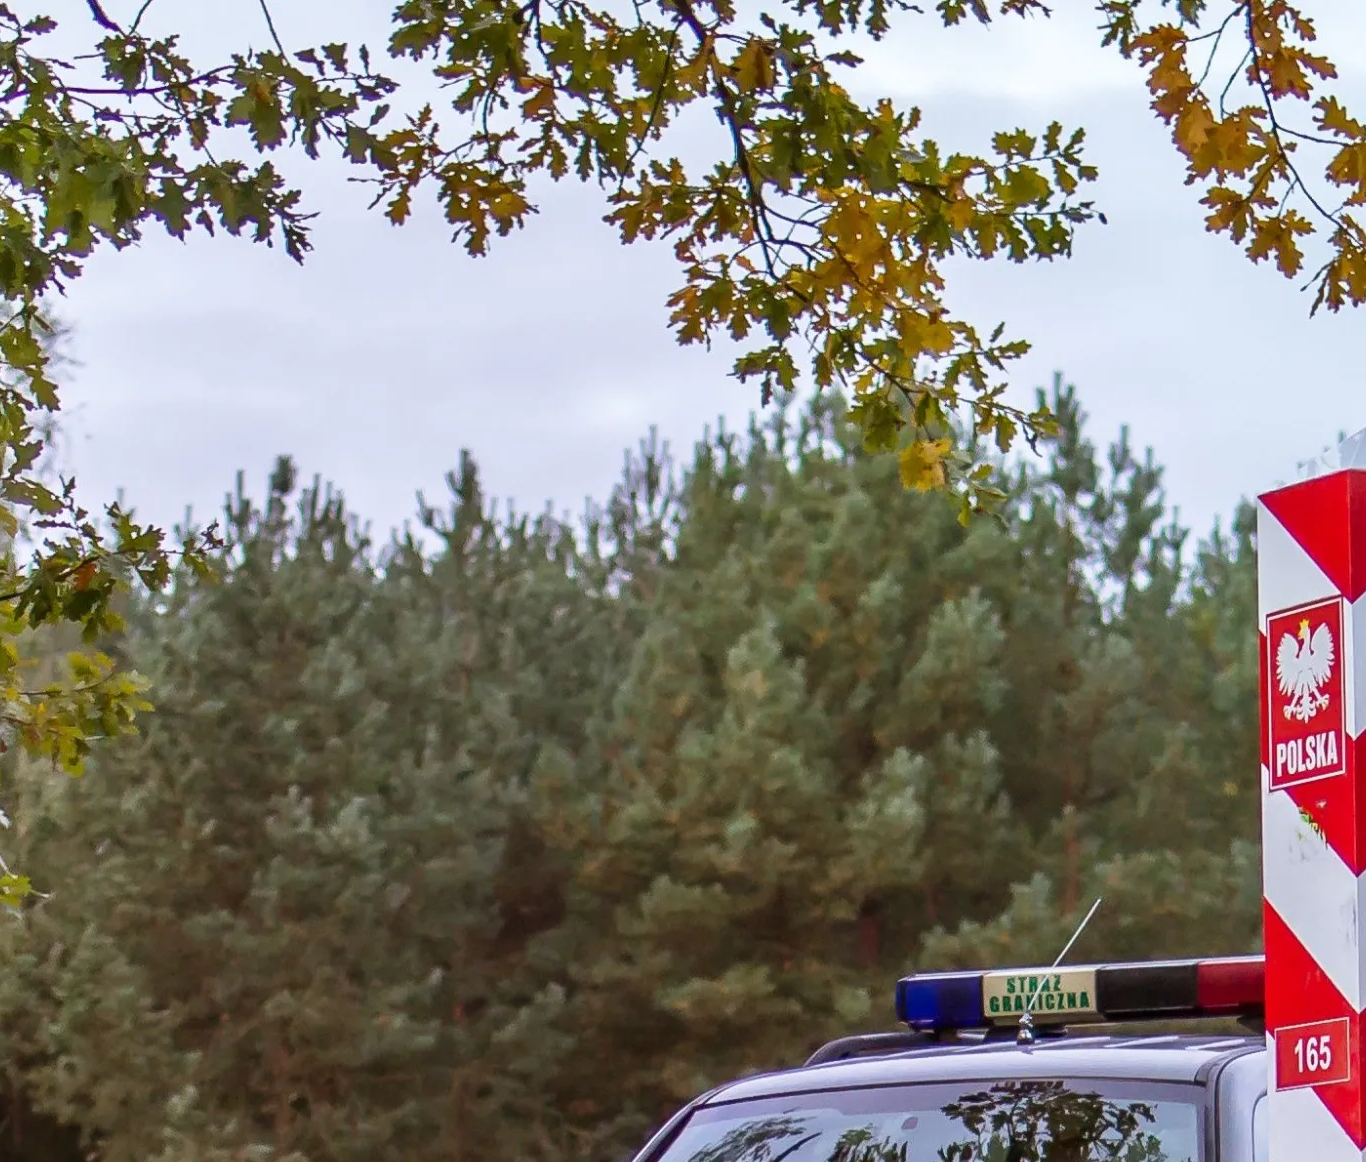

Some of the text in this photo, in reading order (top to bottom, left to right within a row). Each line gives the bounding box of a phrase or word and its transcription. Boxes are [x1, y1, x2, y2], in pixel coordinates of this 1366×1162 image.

[1276, 730, 1338, 777] POLSKA
[989, 991, 1090, 1012] GRANICZNA
[1294, 1035, 1332, 1073] 165
